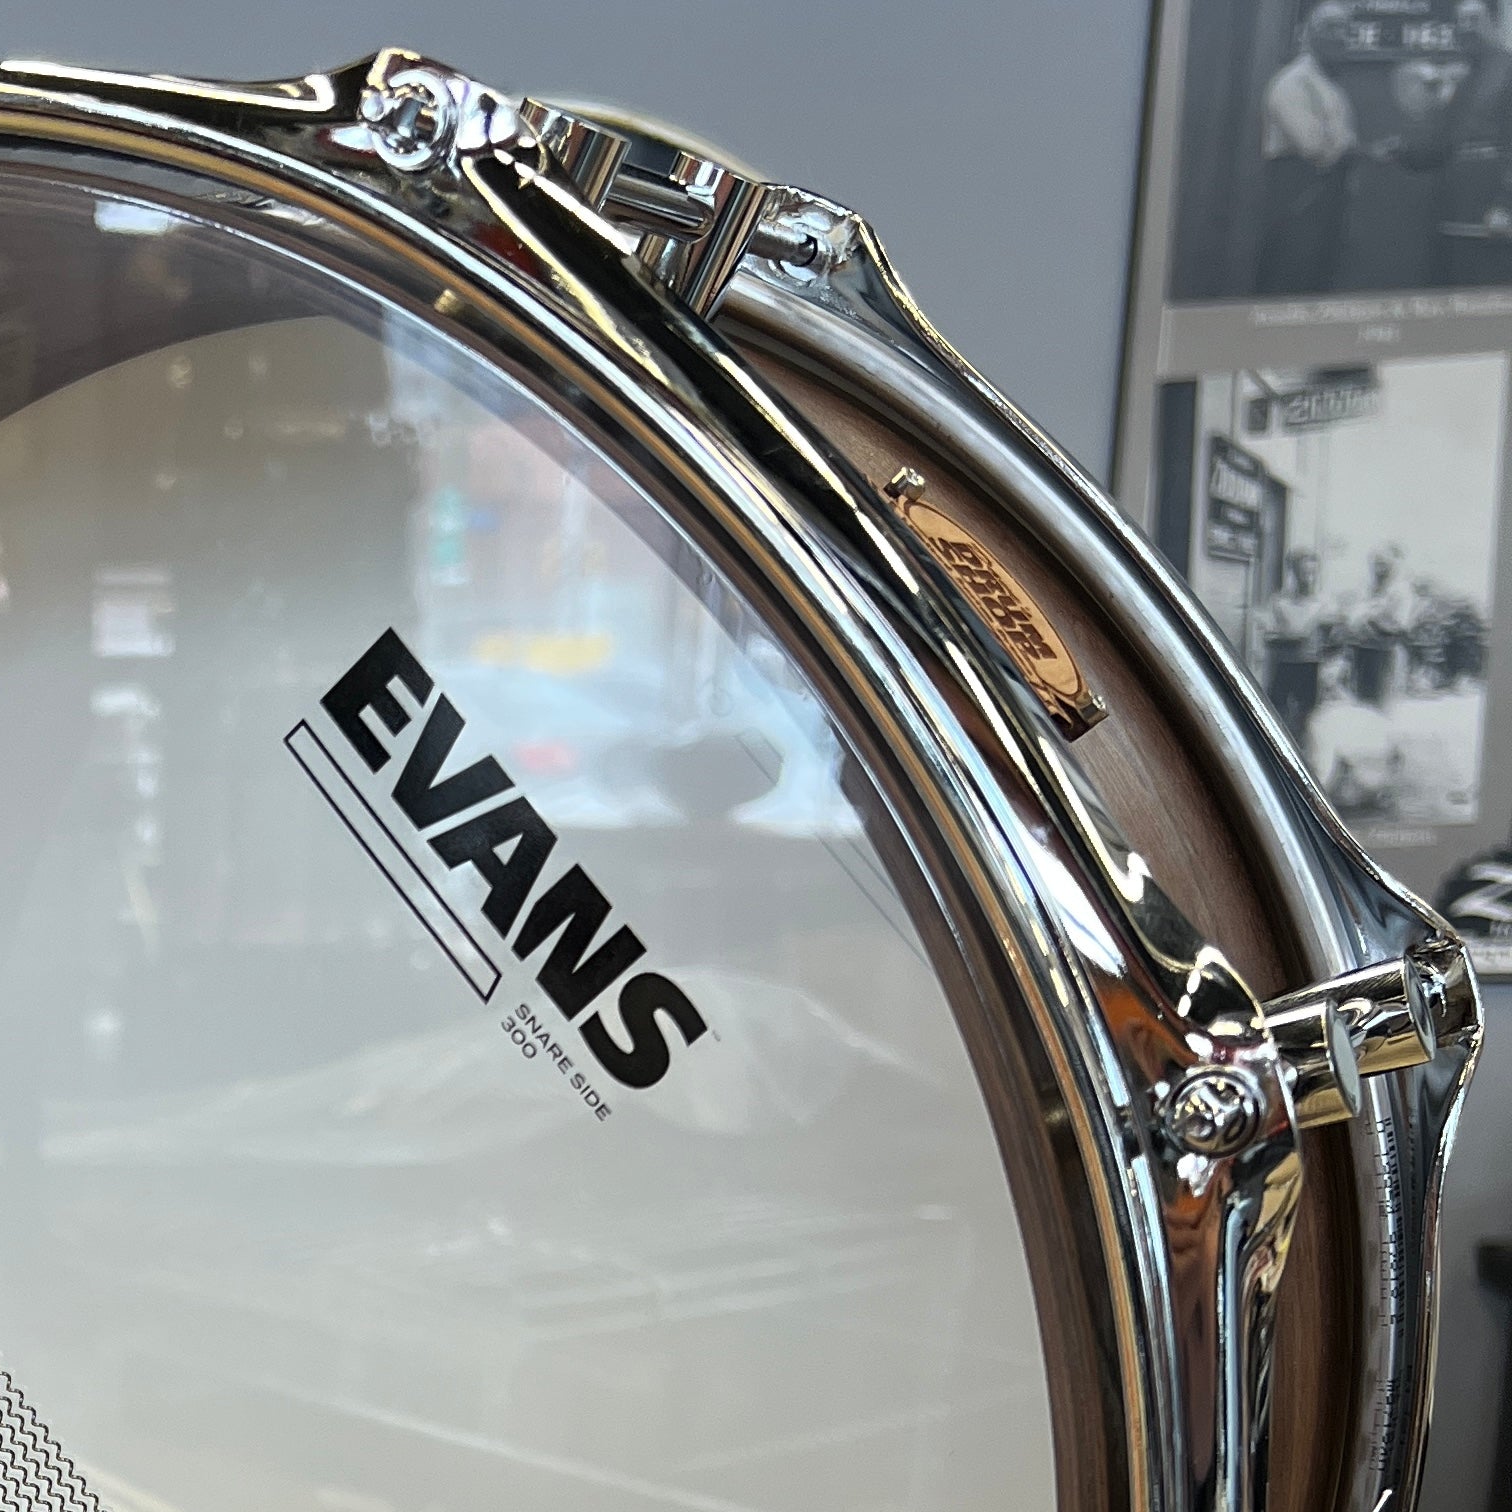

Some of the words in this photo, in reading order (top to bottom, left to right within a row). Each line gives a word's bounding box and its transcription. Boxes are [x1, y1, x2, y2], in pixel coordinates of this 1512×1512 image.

[928, 537, 1041, 660] SHOP
[950, 542, 1057, 659] DRUM
[319, 626, 709, 1090] EVANS
[501, 1016, 537, 1059] 300
[515, 1003, 574, 1075] SNARE
[569, 1072, 612, 1122] SIDE
